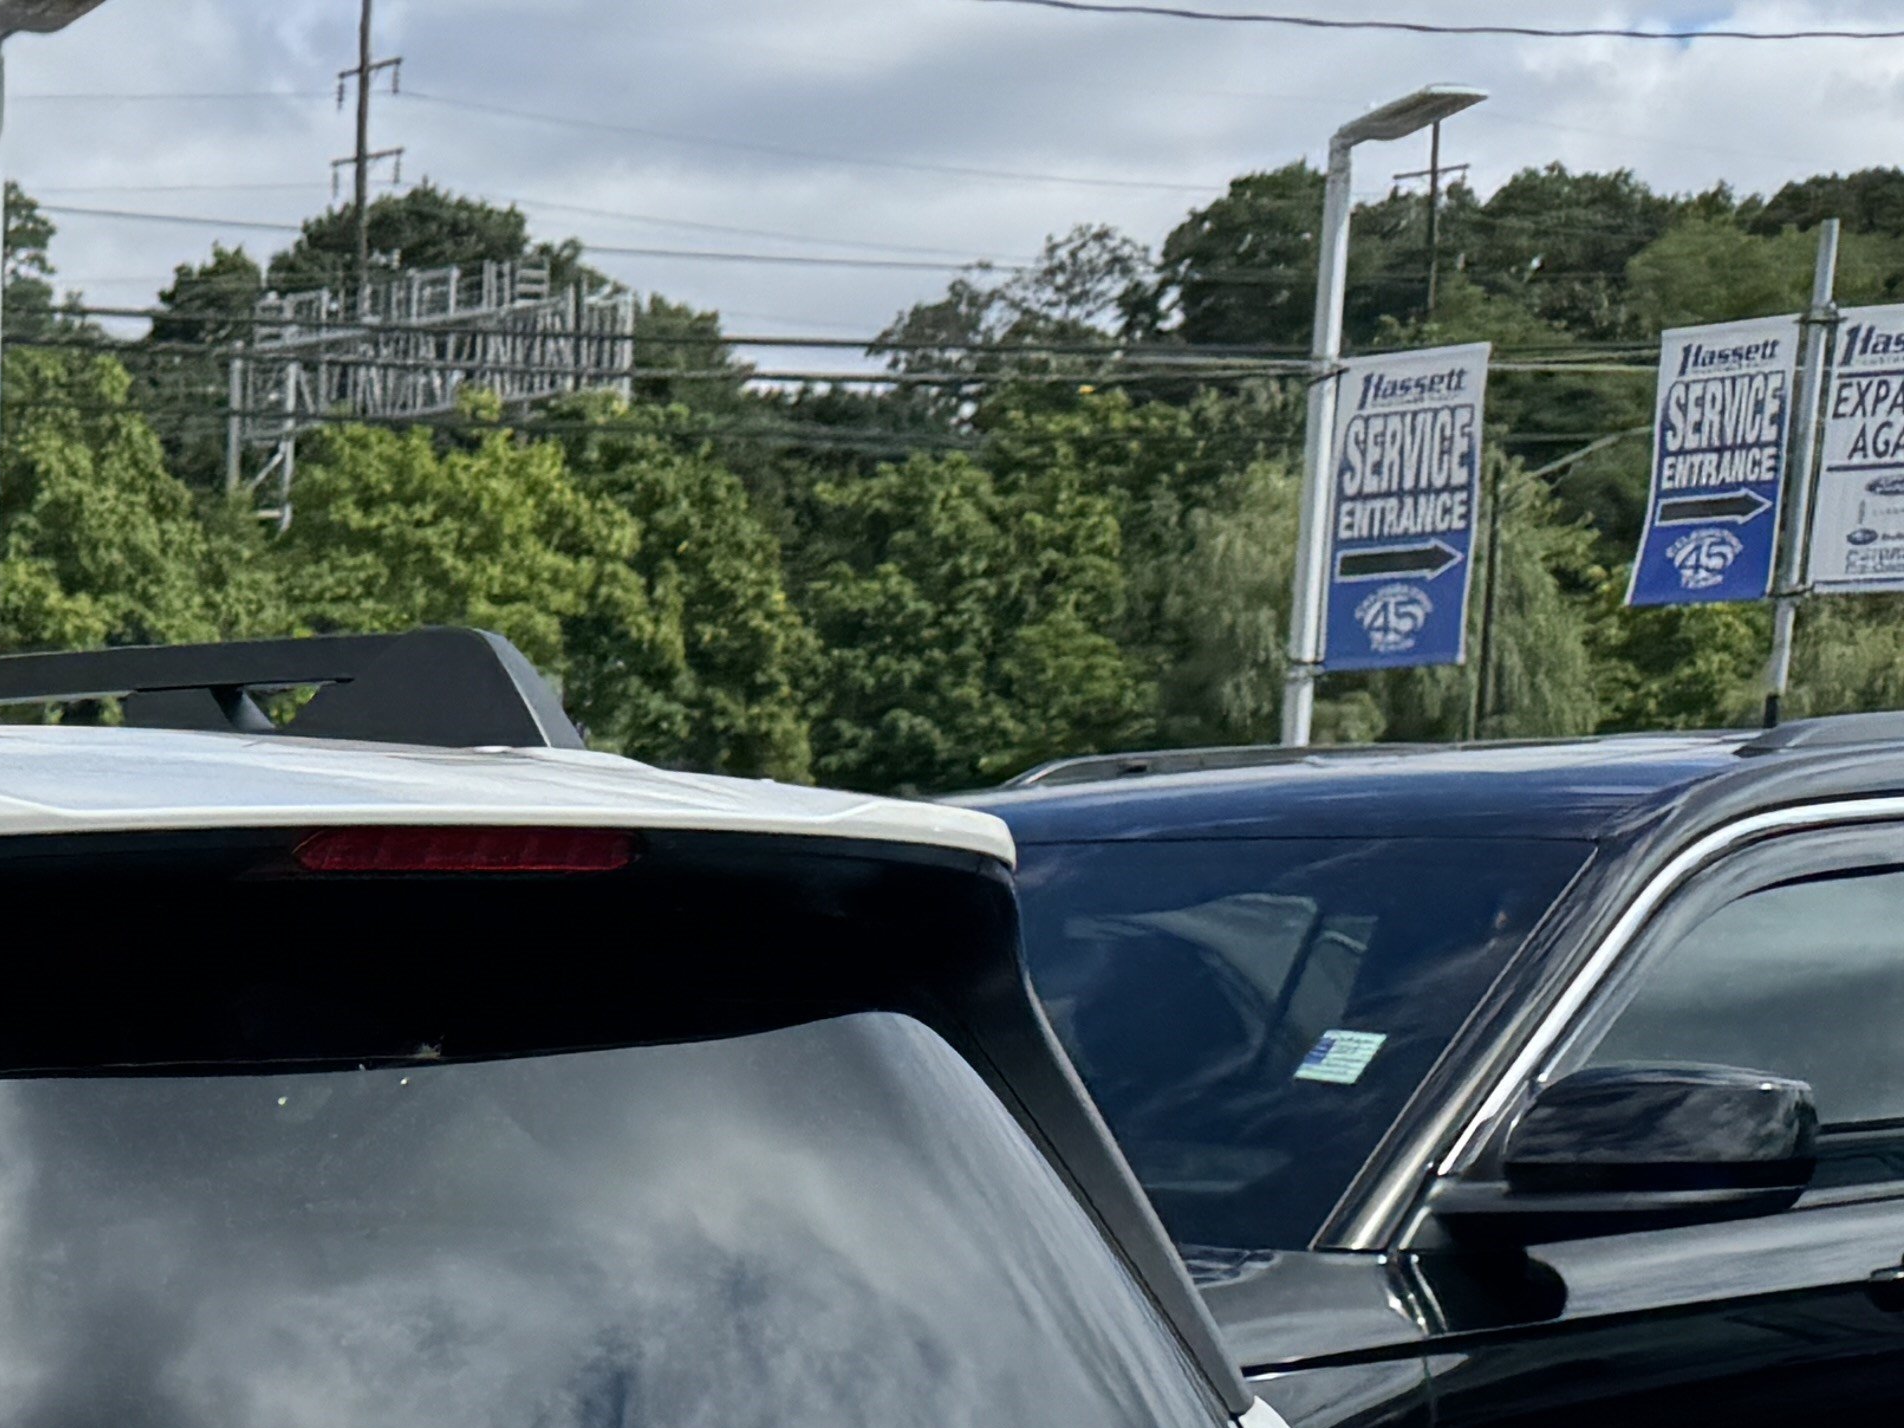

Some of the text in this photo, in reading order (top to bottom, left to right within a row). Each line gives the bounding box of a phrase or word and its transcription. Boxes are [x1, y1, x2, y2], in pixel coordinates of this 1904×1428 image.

[1678, 339, 1780, 377] Hassett
[1357, 367, 1467, 410] Hassett
[1666, 371, 1785, 452] SERVICE
[1343, 406, 1475, 497] SERVICE
[1661, 447, 1778, 489] ENTRANCE
[1338, 490, 1468, 539] ENTRANCE
[1678, 538, 1733, 575] 45
[1365, 598, 1423, 637] 45
